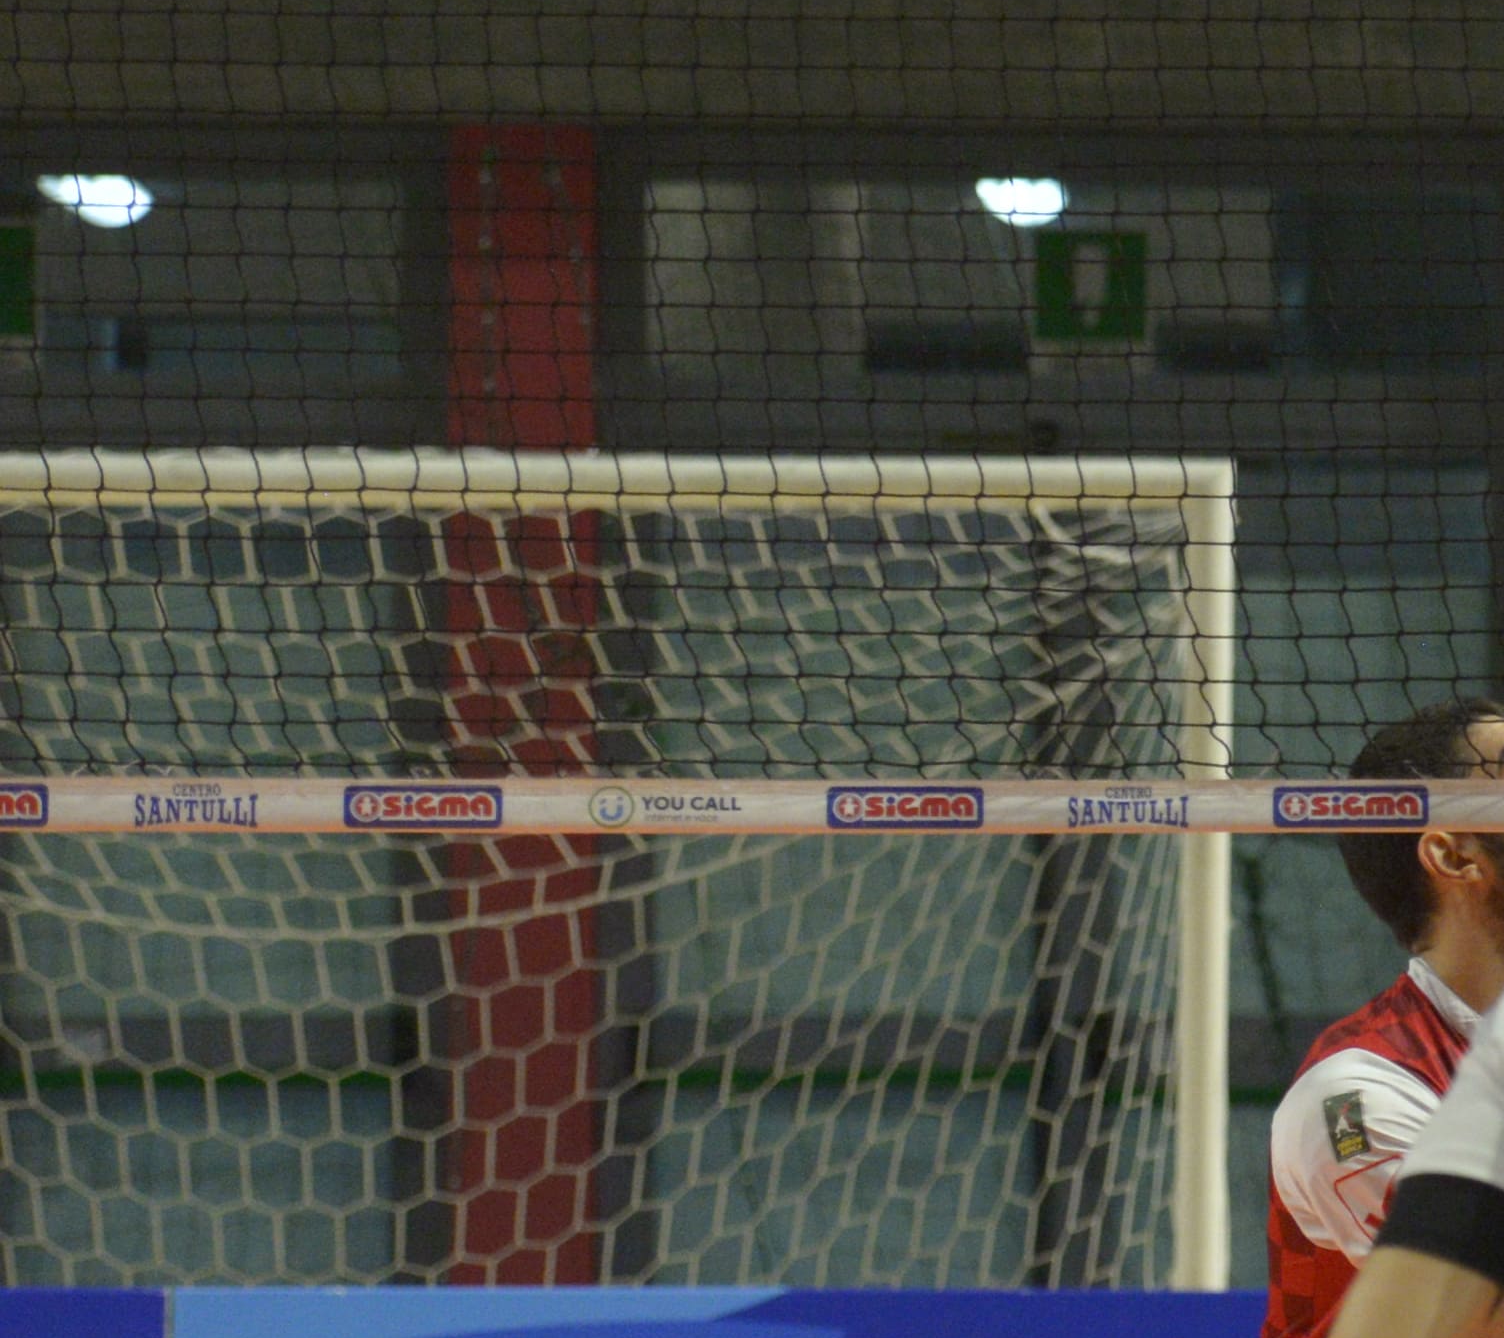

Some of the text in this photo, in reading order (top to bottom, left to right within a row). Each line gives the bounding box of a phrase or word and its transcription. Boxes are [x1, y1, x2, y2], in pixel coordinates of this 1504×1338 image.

[642, 796, 741, 811] YOU CALL
[1105, 786, 1152, 799] CENTRO
[134, 792, 259, 828] SANTULLI
[1068, 797, 1189, 827] SANTULLI
